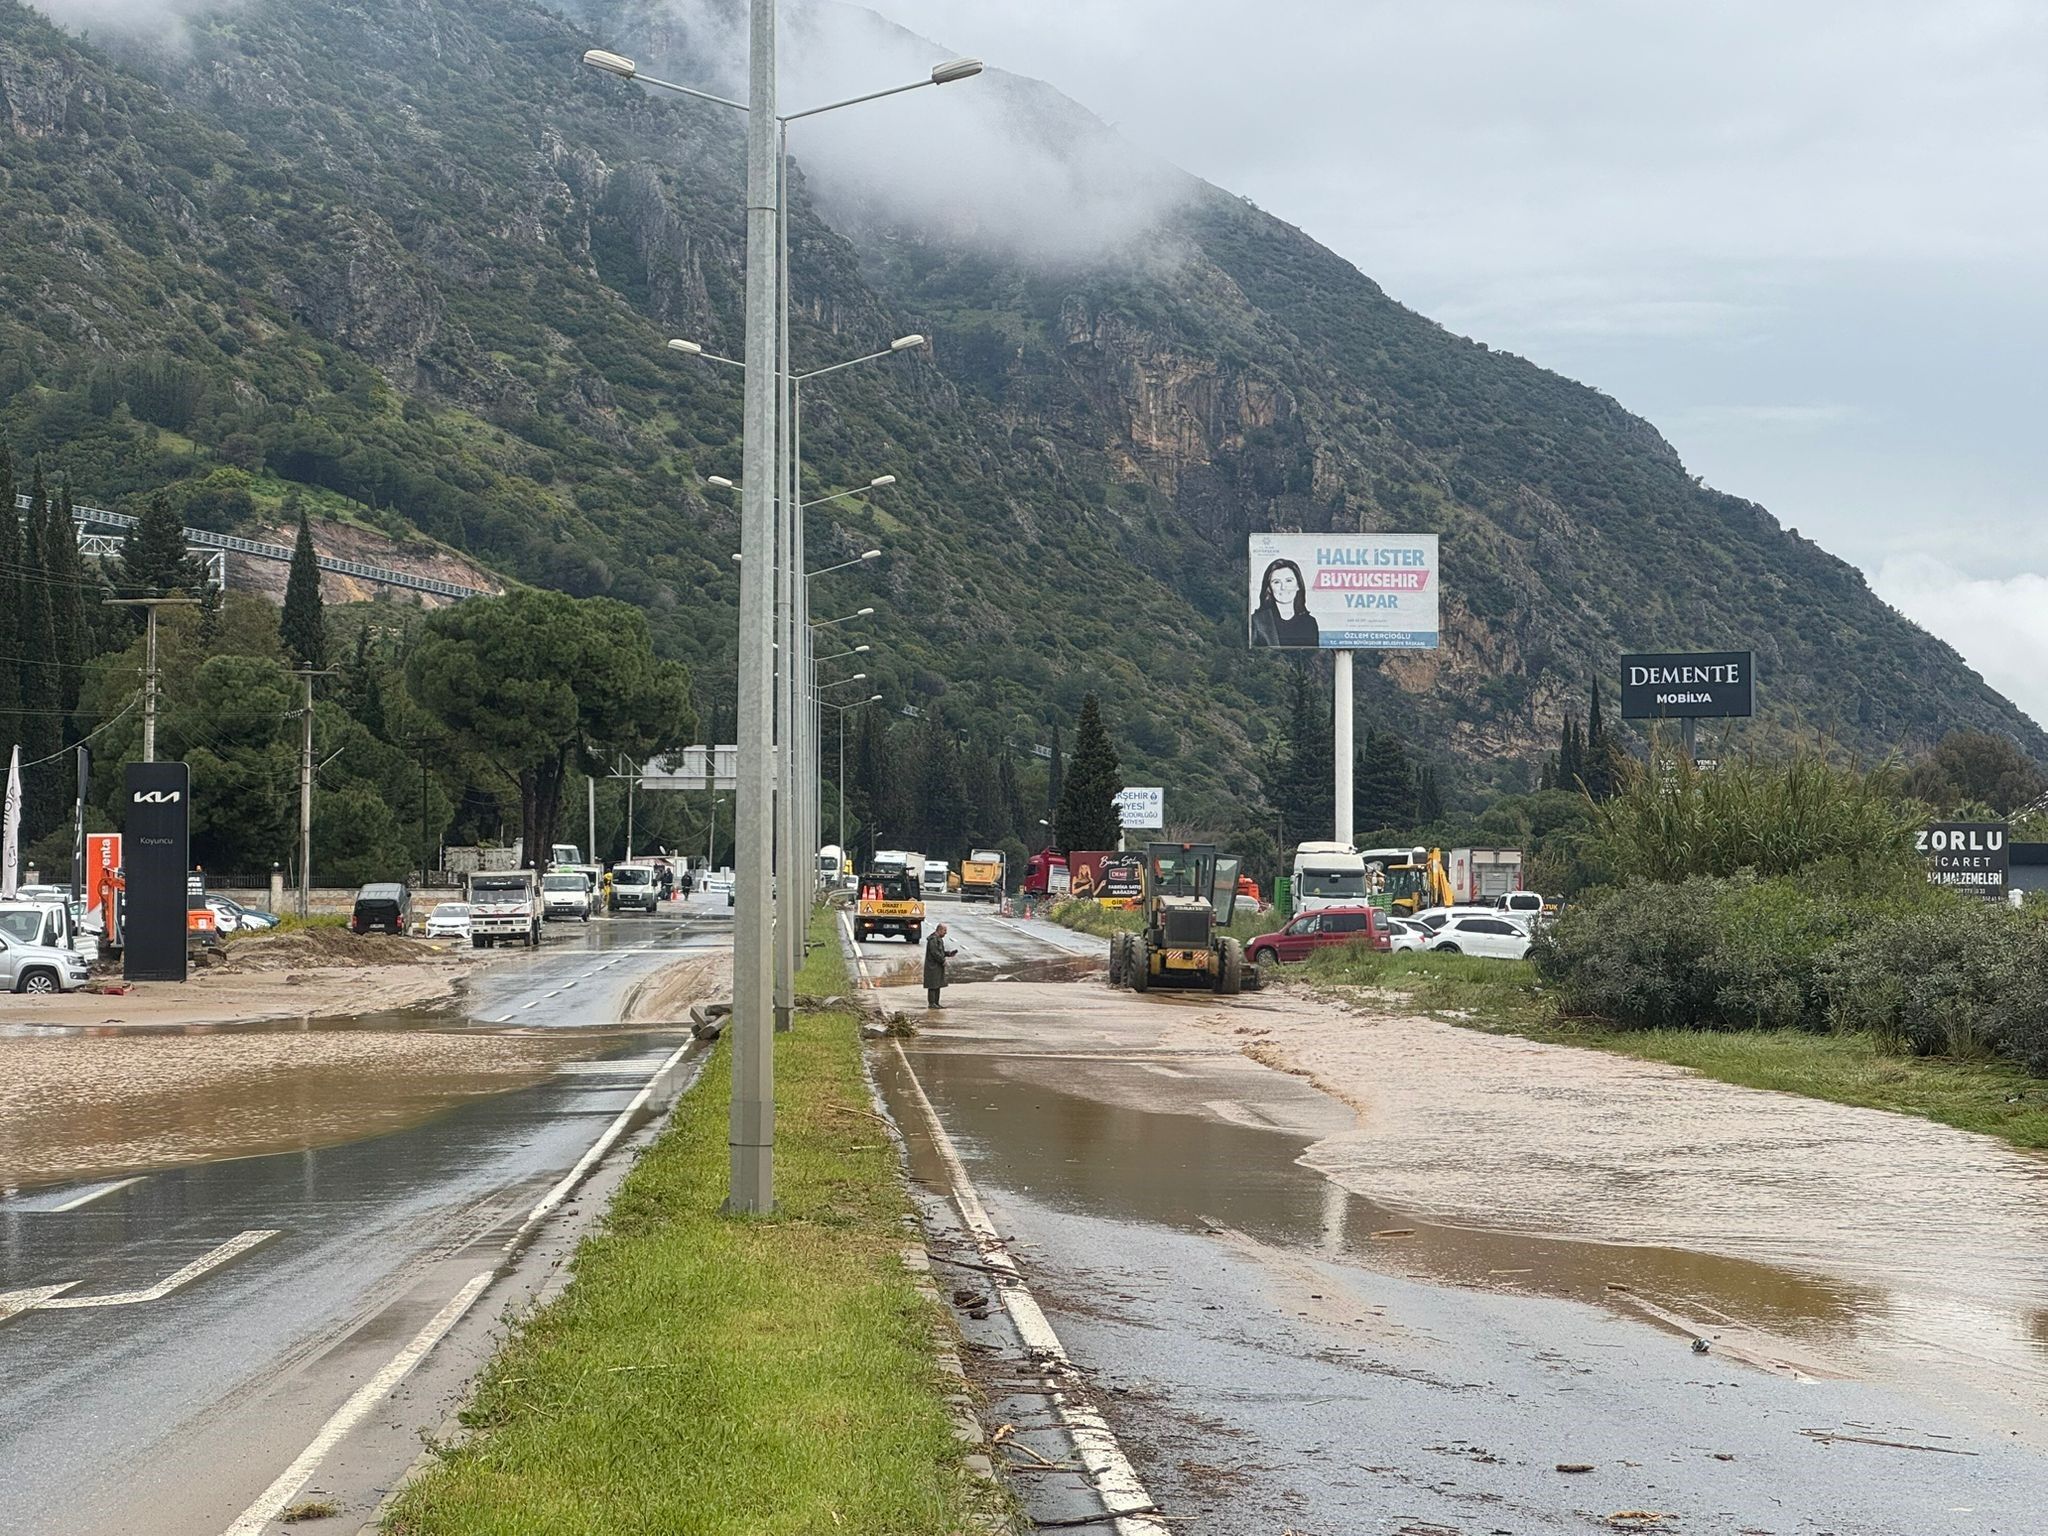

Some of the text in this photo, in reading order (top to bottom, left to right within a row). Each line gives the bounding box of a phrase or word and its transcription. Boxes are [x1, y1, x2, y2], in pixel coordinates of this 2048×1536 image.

[1316, 548, 1425, 566] HALK İSTER
[1344, 593, 1398, 609] YAPAR
[1344, 631, 1369, 640] ÖZLEM
[1629, 663, 1740, 686] DEMENTE
[1656, 690, 1712, 704] MOBİLYA
[1117, 791, 1149, 801] KŞEHİR
[140, 836, 174, 846] Koyuncu
[1915, 830, 2003, 851] ZORLU
[1926, 871, 1942, 885] API
